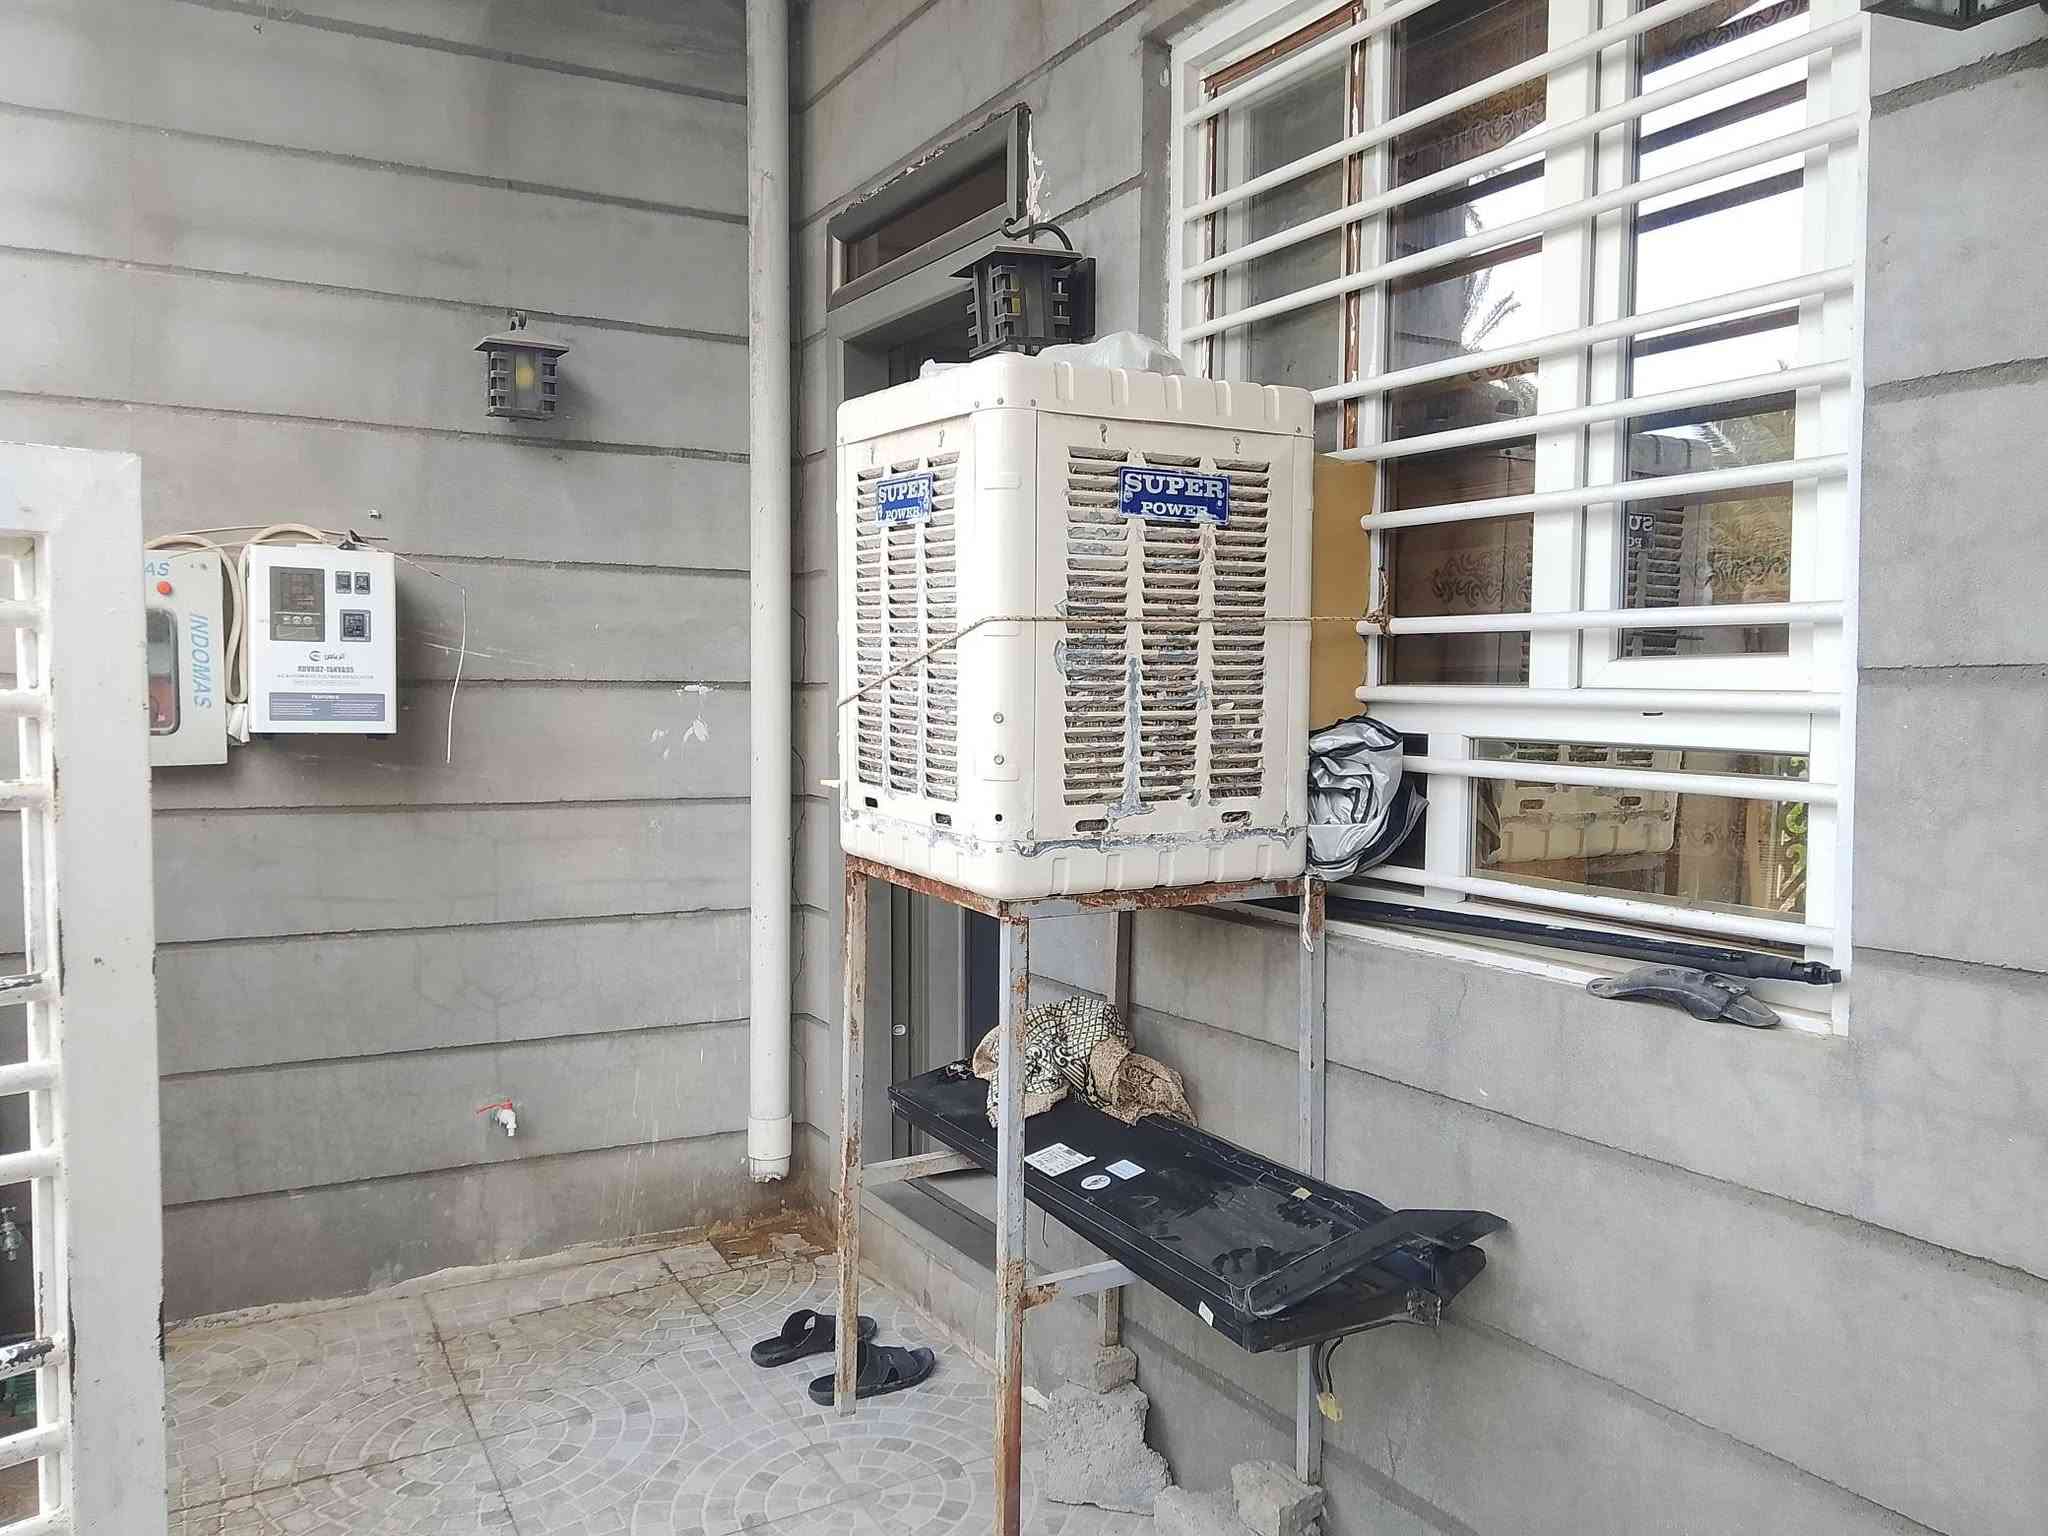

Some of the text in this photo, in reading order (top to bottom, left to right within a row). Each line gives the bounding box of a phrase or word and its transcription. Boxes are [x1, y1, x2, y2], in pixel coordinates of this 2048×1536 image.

[879, 480, 929, 503] SUPER
[1124, 473, 1225, 498] SUPER
[886, 506, 919, 520] POWER
[1141, 501, 1208, 516] POWER
[190, 614, 212, 709] INDOMAS
